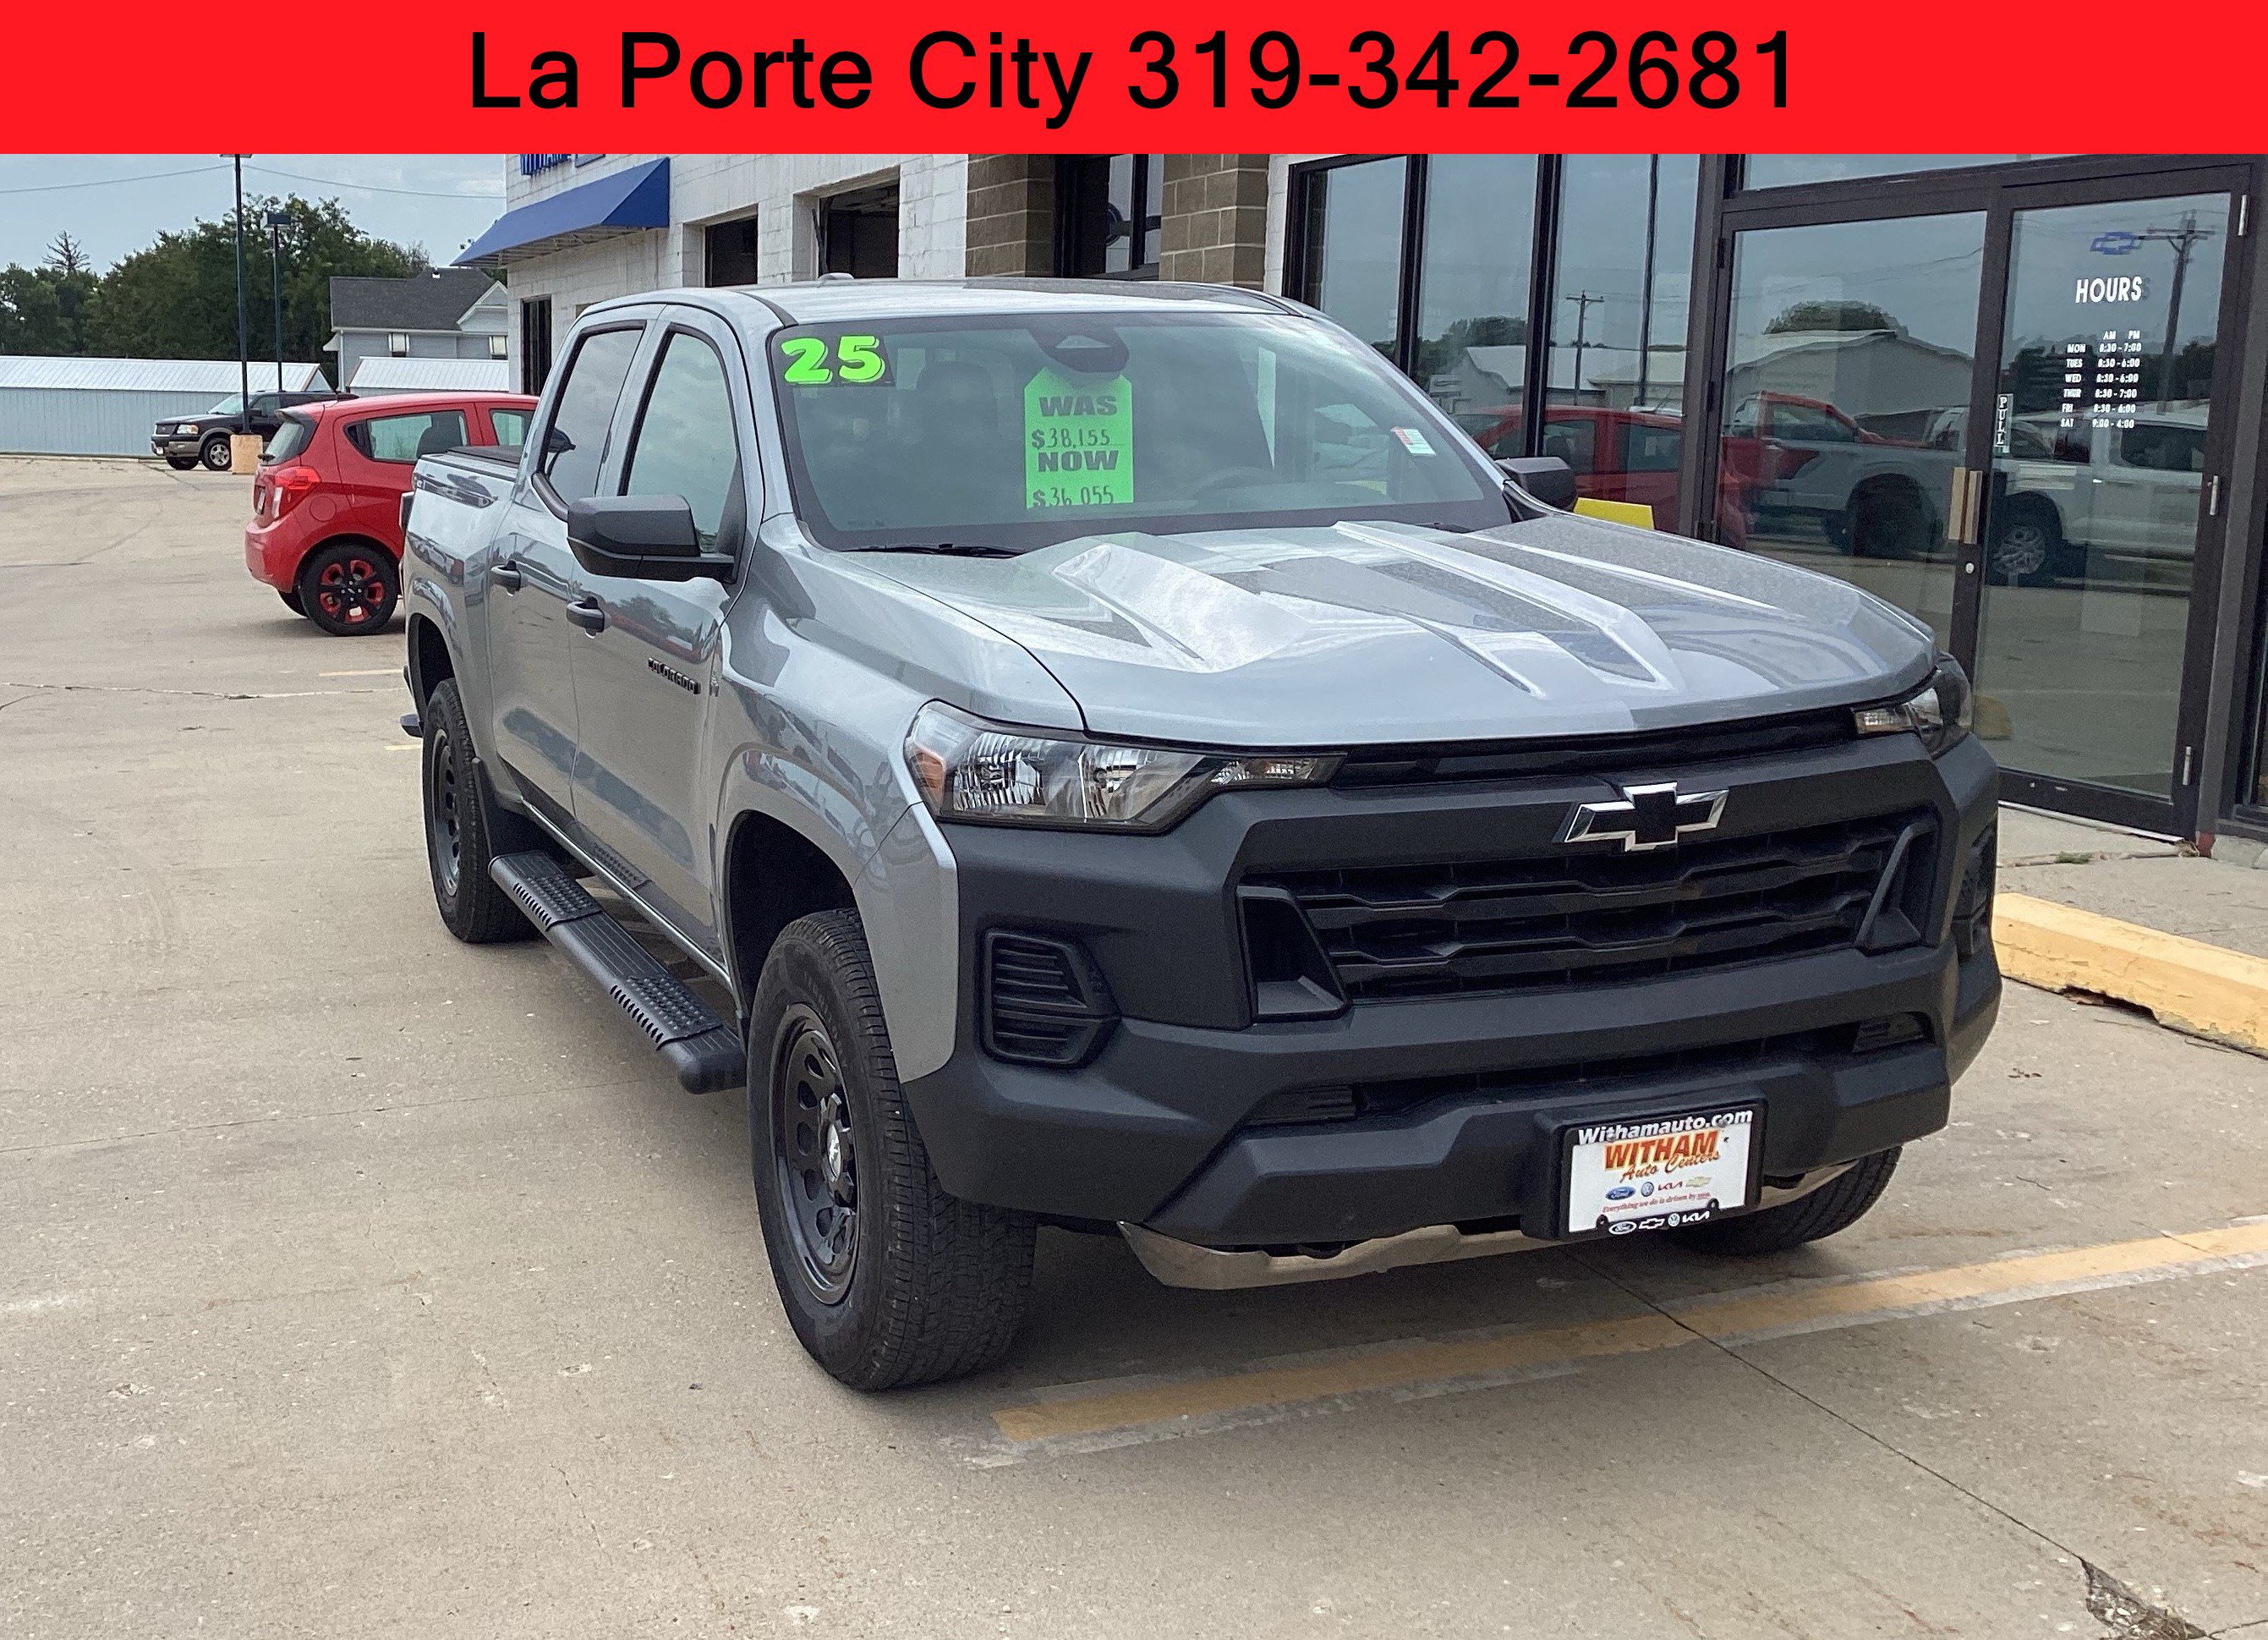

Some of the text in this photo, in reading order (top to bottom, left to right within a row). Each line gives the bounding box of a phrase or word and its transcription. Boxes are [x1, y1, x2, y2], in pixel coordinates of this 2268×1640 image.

[2075, 277, 2142, 303] HOURS
[2103, 330, 2140, 339] AM PM
[2067, 343, 2085, 353] MON
[781, 335, 885, 384] 25
[2066, 359, 2083, 368] TUES
[2065, 374, 2081, 382] WED
[1039, 395, 1118, 417] WAS
[2062, 403, 2074, 412] FRI
[1997, 396, 2008, 445] PULL
[2061, 418, 2074, 427] SAT
[1038, 450, 1119, 472] NOW
[1578, 1110, 1753, 1145] Withamauto.com
[1605, 1131, 1719, 1169] WITHAM
[1619, 1150, 1720, 1183] Auto Centers
